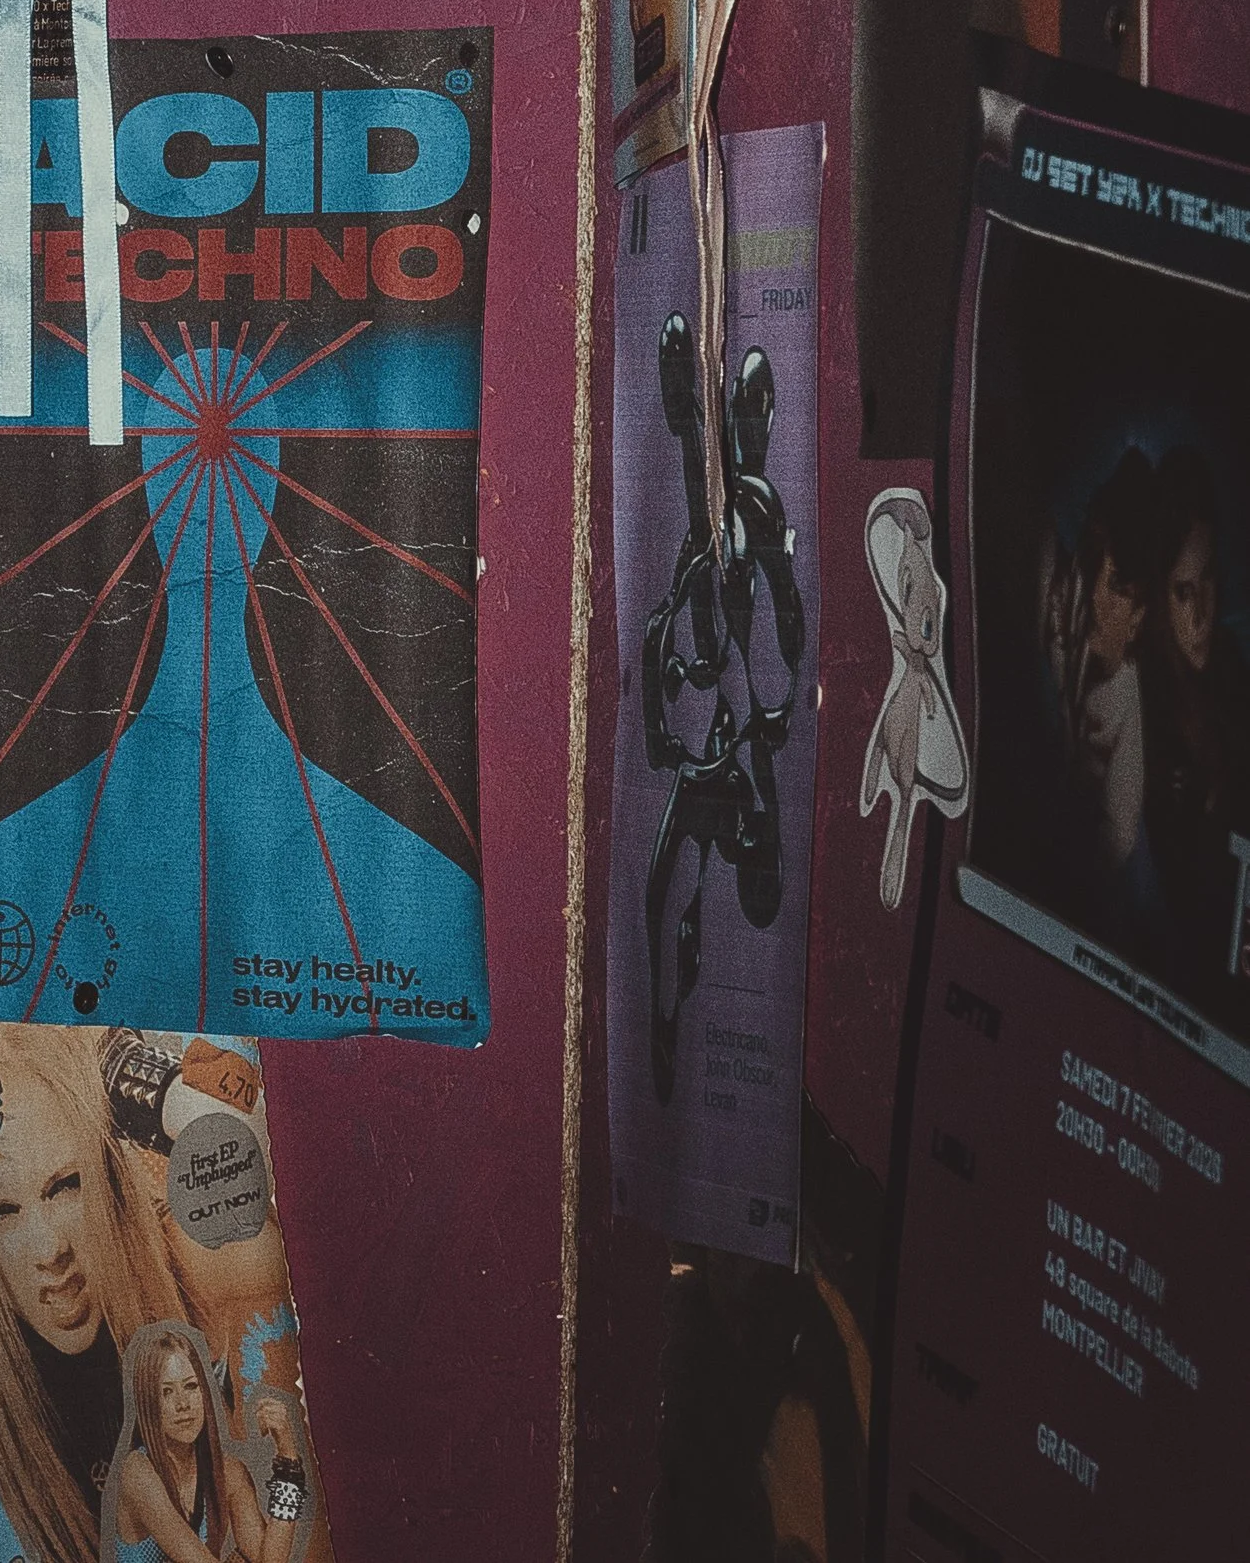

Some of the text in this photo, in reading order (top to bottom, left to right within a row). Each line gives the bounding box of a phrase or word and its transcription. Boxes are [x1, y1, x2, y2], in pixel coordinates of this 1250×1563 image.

[1047, 154, 1094, 198] SET
[760, 287, 813, 312] FRIDAY
[233, 953, 422, 990] stay healty.
[233, 984, 477, 1022] stay hydrated.
[219, 1071, 255, 1108] 4.70
[1061, 1049, 1117, 1111] SAMEDI
[1120, 1085, 1130, 1116] 7
[1056, 1099, 1105, 1155] 20H30
[190, 1140, 240, 1175] first EP
[187, 1188, 262, 1223] OUT NOW
[1047, 1198, 1070, 1240] UN
[1072, 1212, 1105, 1262] BAR
[1068, 1271, 1119, 1325] square
[1043, 1298, 1143, 1397] MONTPELLIER
[1036, 1421, 1099, 1493] GRATUIT
